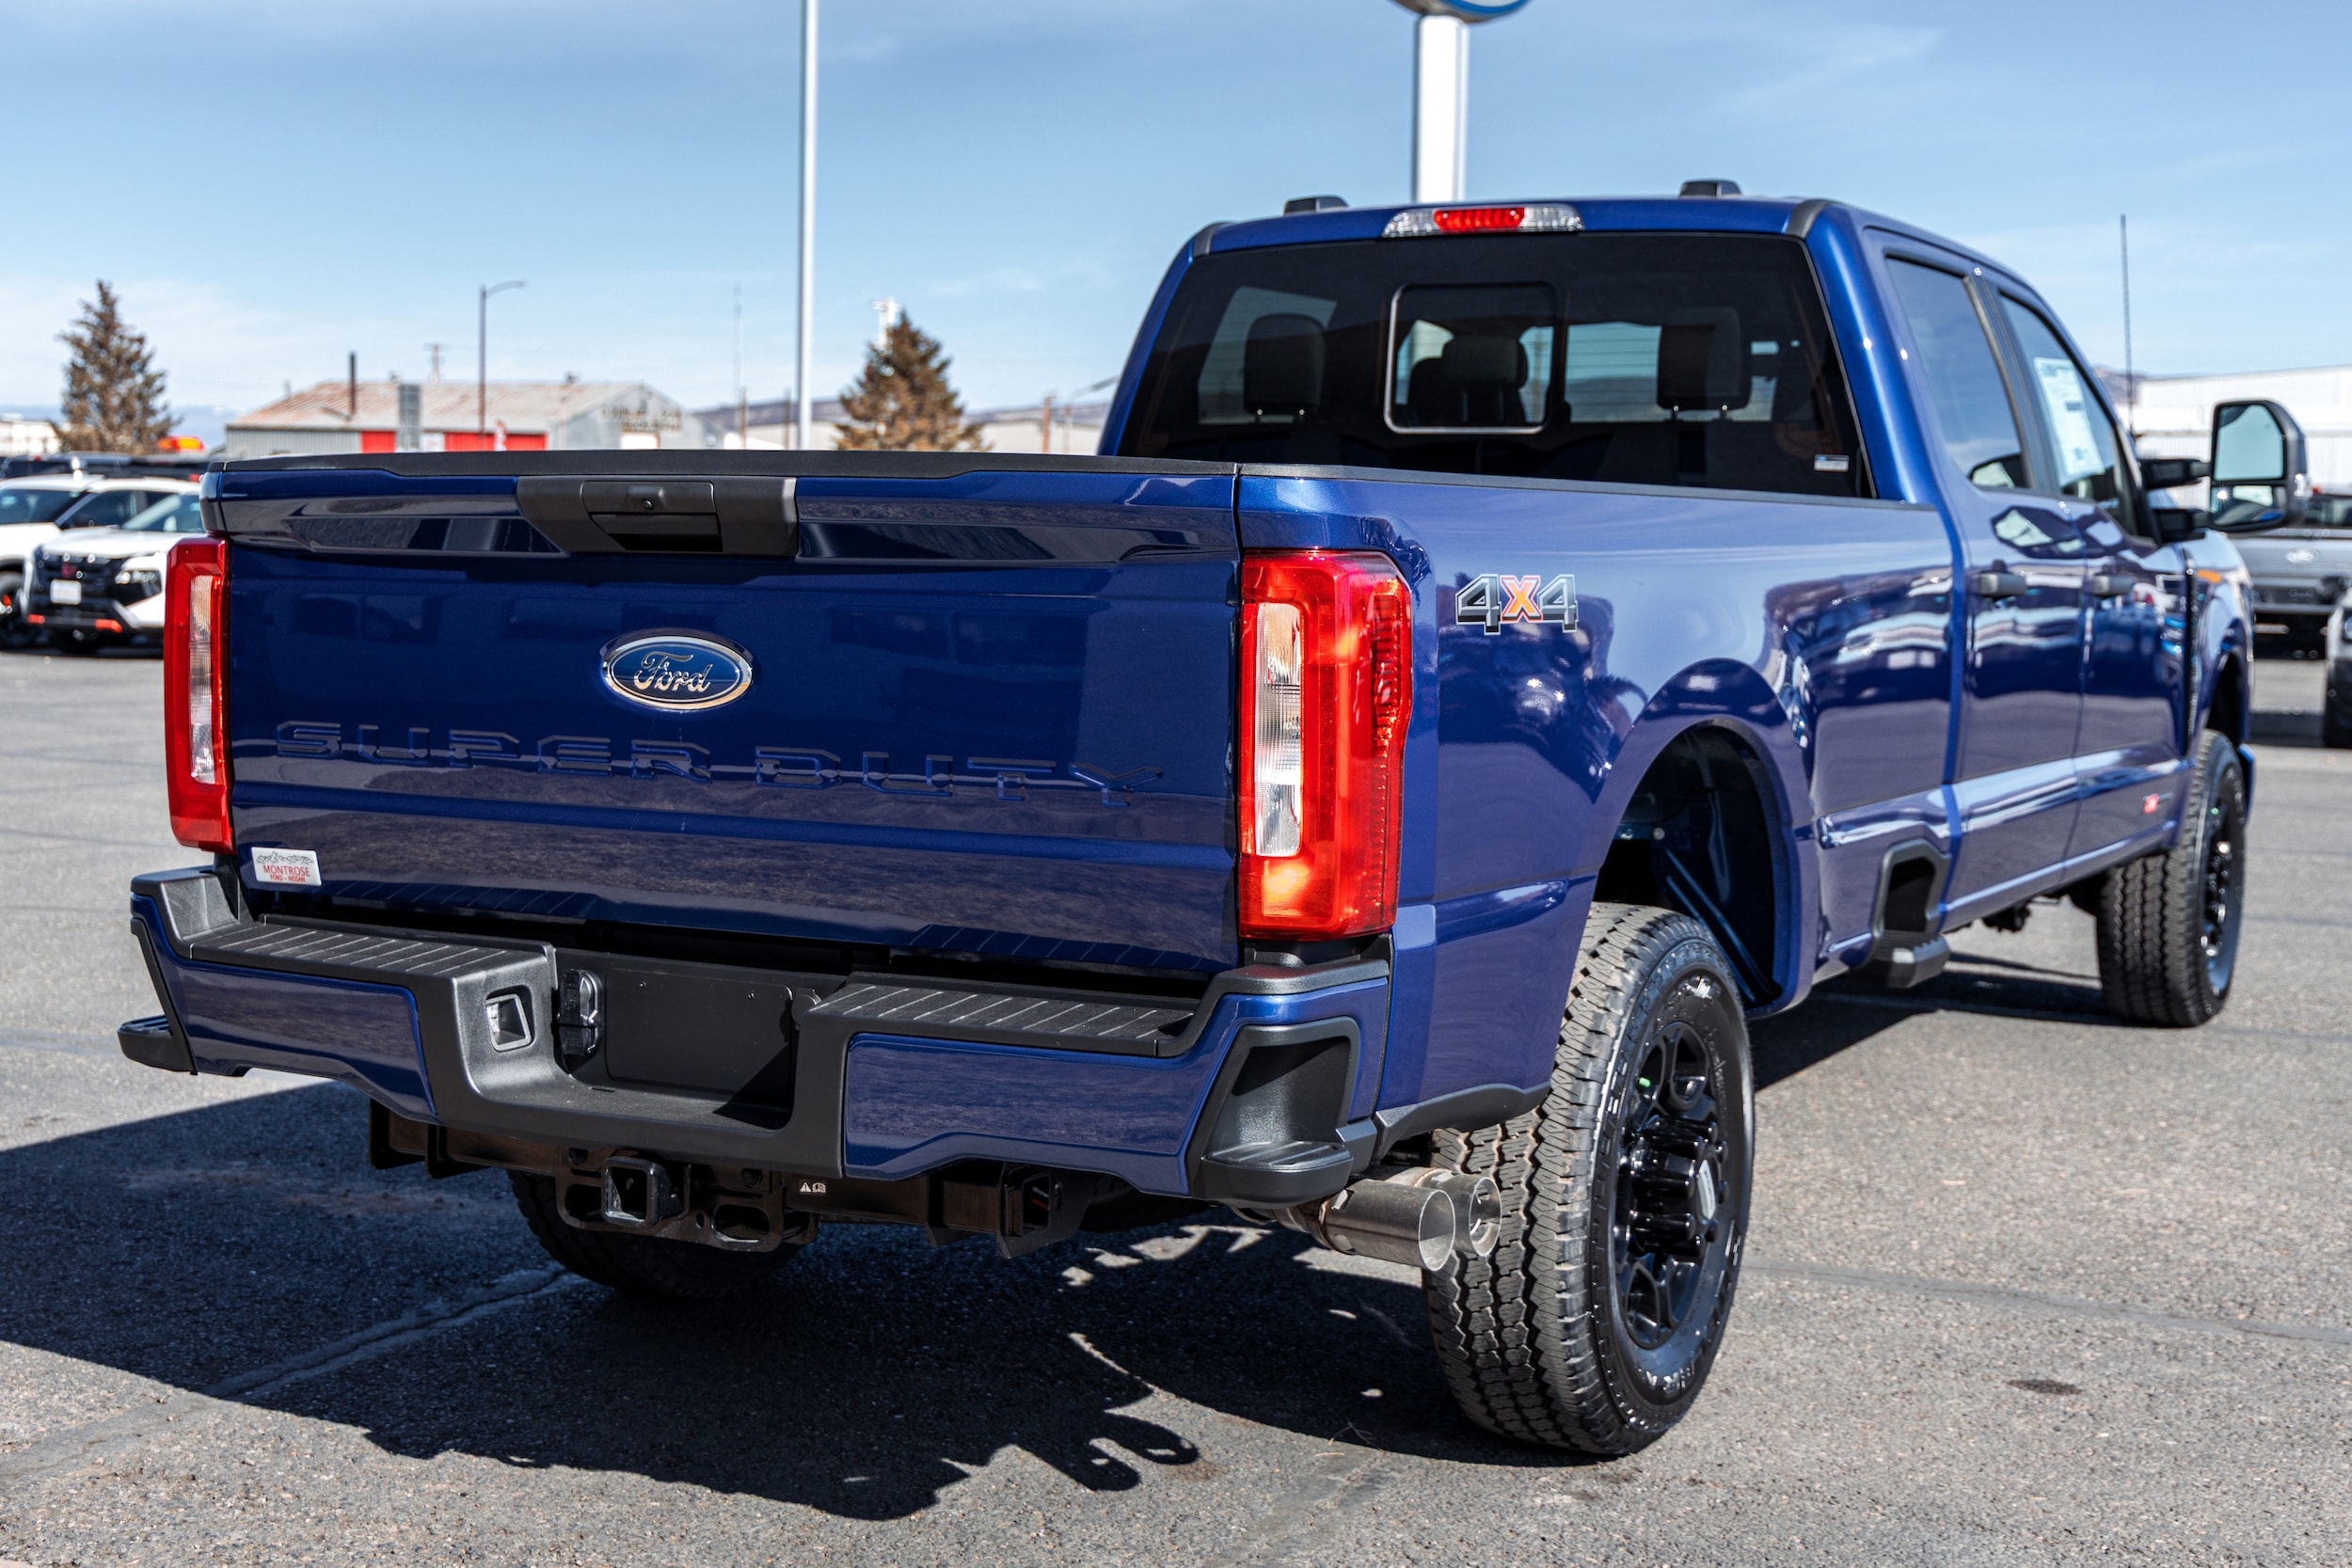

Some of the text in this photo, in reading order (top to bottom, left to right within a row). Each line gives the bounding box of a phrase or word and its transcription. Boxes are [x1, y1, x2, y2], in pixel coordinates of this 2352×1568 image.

[633, 650, 713, 692] Ford
[277, 721, 1164, 806] SUPER DUTY
[263, 864, 310, 877] MONTROSE
